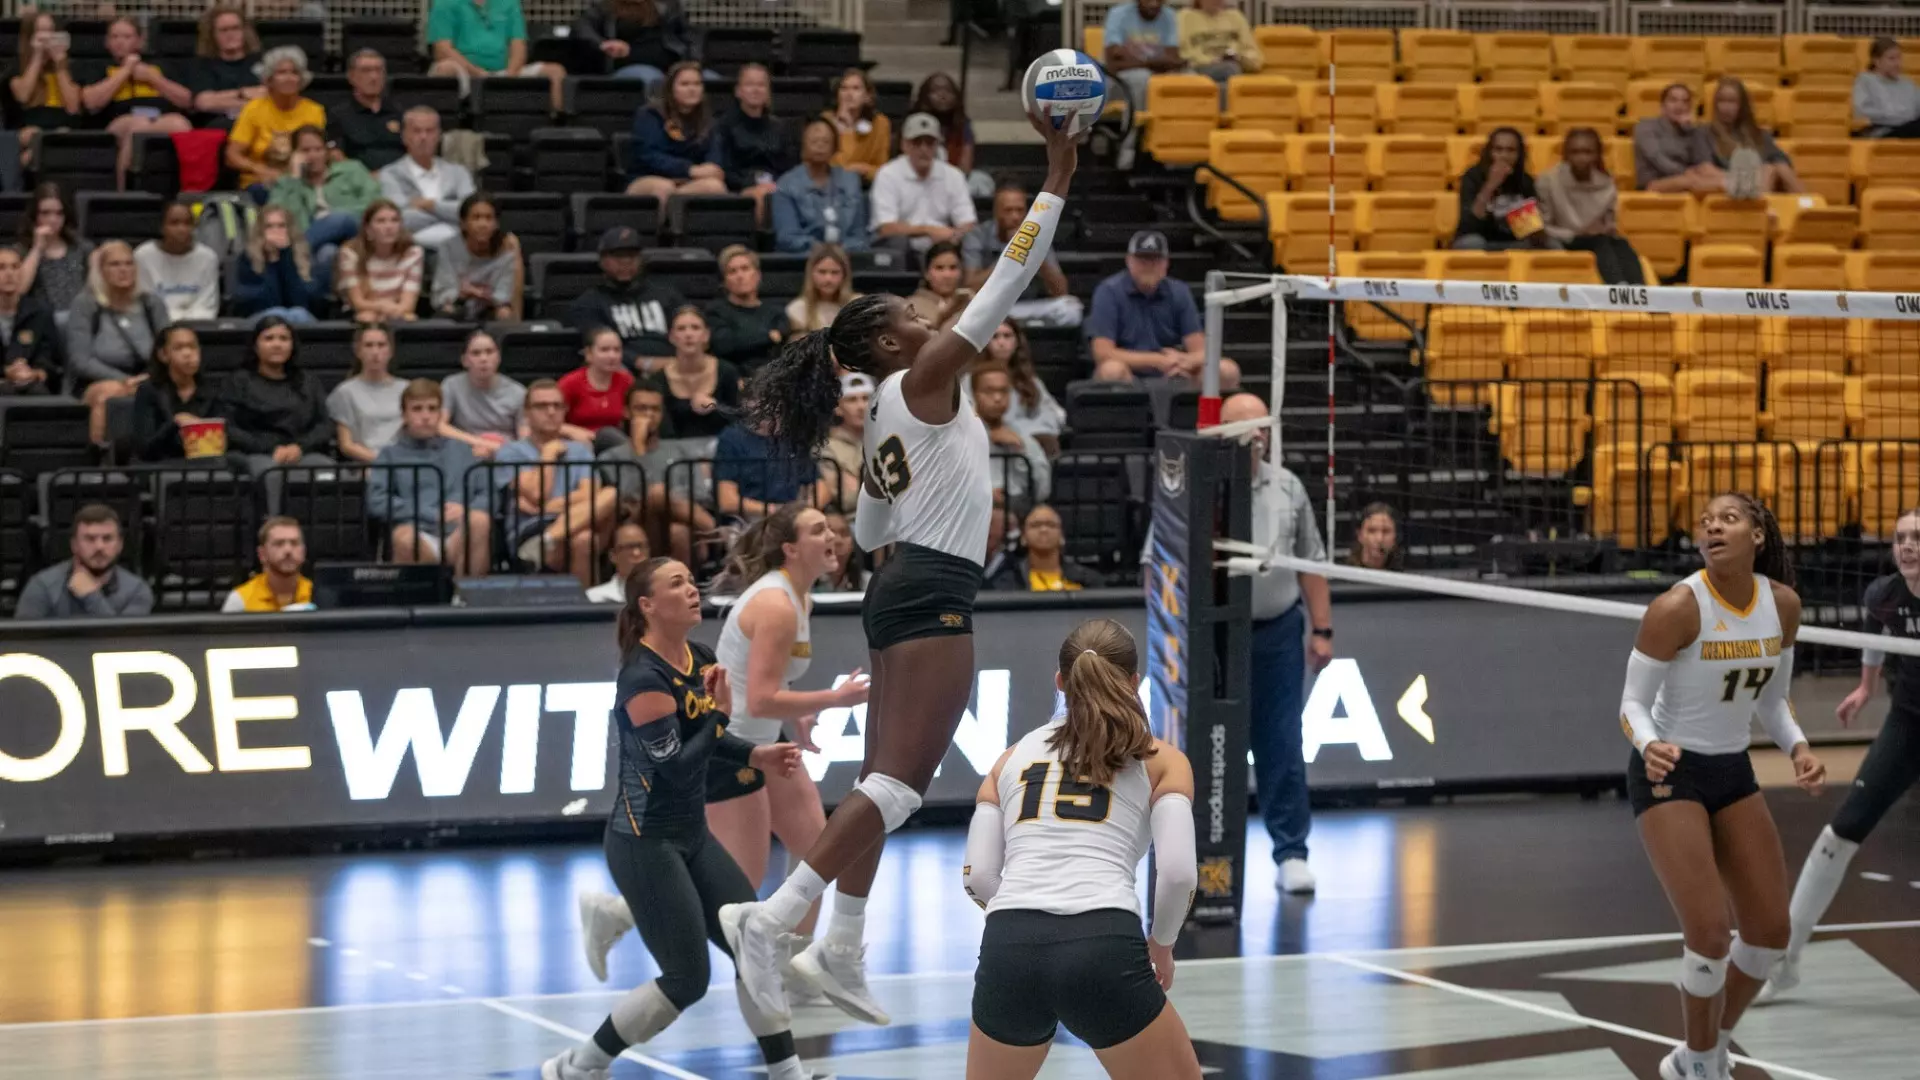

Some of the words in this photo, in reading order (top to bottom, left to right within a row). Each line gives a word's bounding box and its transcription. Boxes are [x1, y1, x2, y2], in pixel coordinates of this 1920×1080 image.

[1046, 66, 1093, 80] molten
[1004, 221, 1041, 266] HOO
[1364, 280, 1399, 297] OWLS
[1481, 284, 1519, 301] OWLS
[1609, 287, 1648, 305] OWLS
[1746, 292, 1790, 310] OWLS
[872, 434, 911, 504] 13
[1701, 640, 1762, 660] KENNESAW
[1720, 666, 1775, 702] 14
[326, 681, 617, 800] WIT
[1209, 724, 1226, 777] sports
[1017, 760, 1113, 824] 15
[1207, 778, 1225, 844] imports
